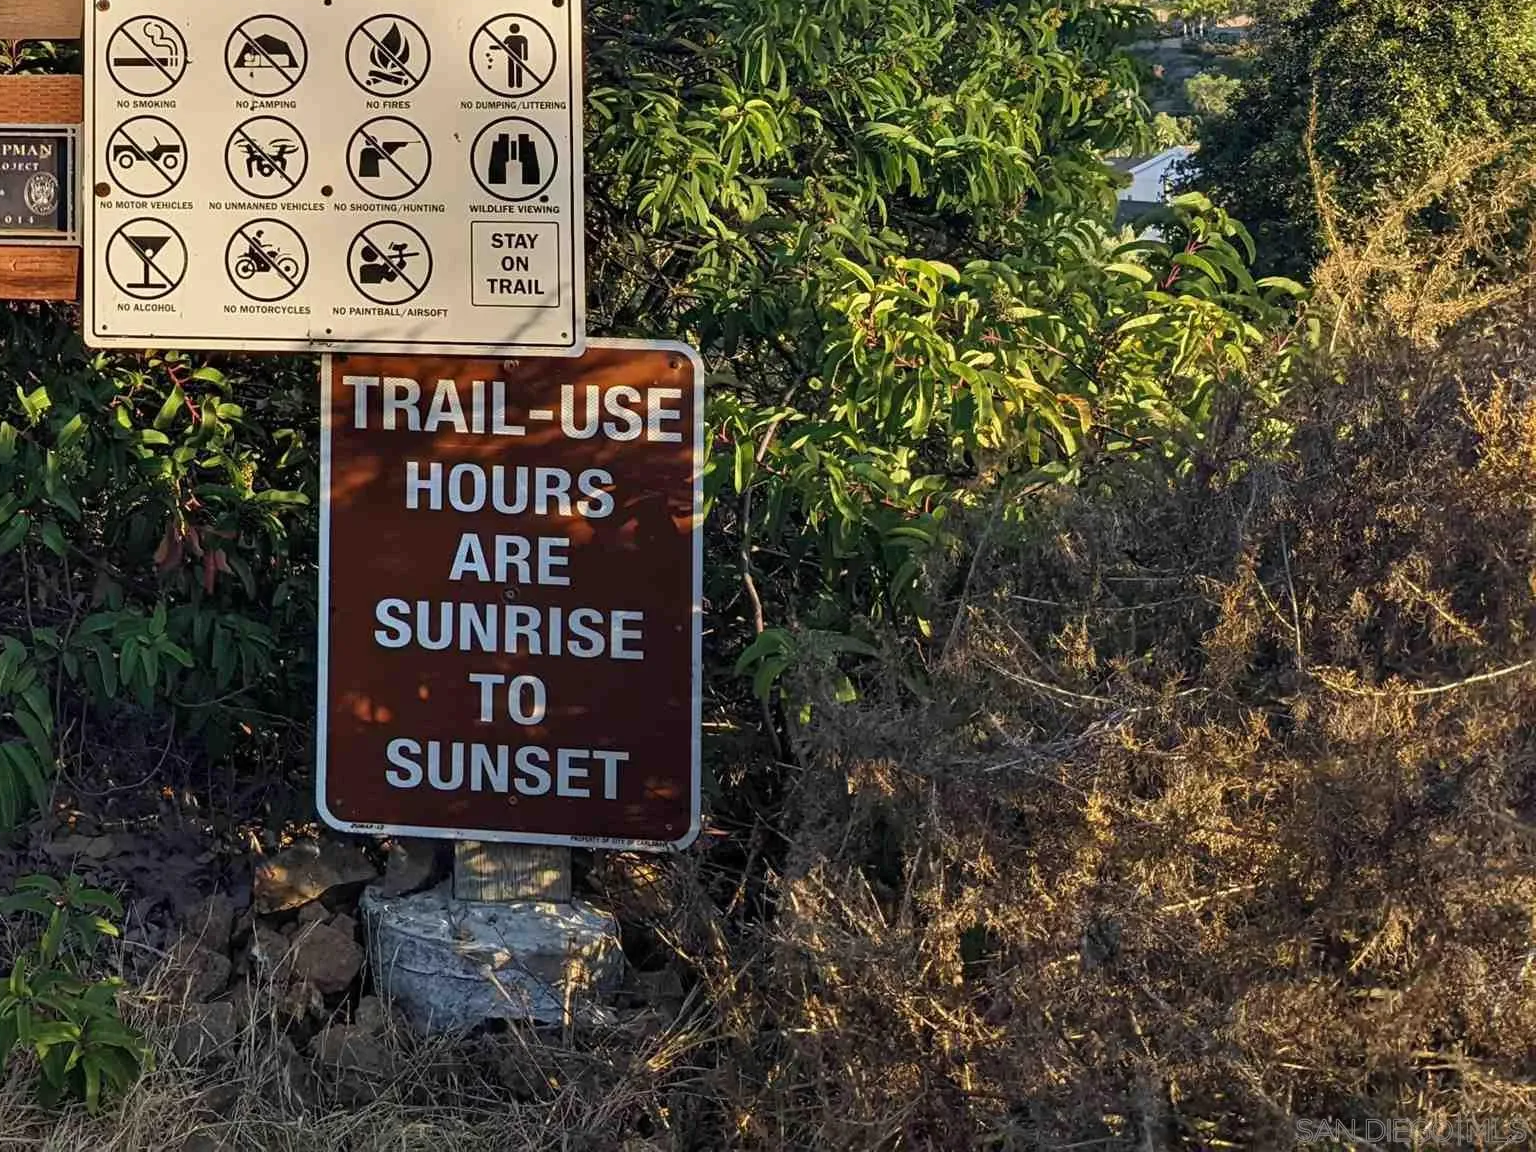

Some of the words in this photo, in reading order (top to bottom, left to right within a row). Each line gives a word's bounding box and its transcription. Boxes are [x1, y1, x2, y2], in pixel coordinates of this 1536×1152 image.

[117, 101, 129, 109] NO
[132, 101, 177, 109] SMOKING
[236, 101, 249, 109] NO
[252, 101, 296, 109] CAMPING
[366, 101, 380, 109] NO
[383, 101, 411, 109] FIRES
[460, 101, 472, 109] NO
[100, 201, 112, 209] NO
[150, 202, 193, 210] VEHICLES
[209, 202, 222, 210] NO
[280, 203, 325, 211] VEHICLES
[334, 204, 347, 212] NO
[469, 204, 514, 213] WILDLIFE
[518, 205, 560, 214] VIEWING
[491, 233, 539, 249] STAY
[501, 256, 529, 272] ON
[487, 278, 544, 295] TRAIL
[133, 304, 176, 312] ALCOHOL
[224, 305, 237, 313] NO
[240, 306, 311, 314] MOTORCYCLES
[333, 307, 346, 316] NO
[342, 375, 682, 443] TRAIL-USE
[406, 460, 615, 519] HOURS
[449, 533, 570, 586] ARE
[374, 598, 645, 661] SUNRISE
[468, 673, 546, 726] TO
[385, 738, 630, 800] SUNSET
